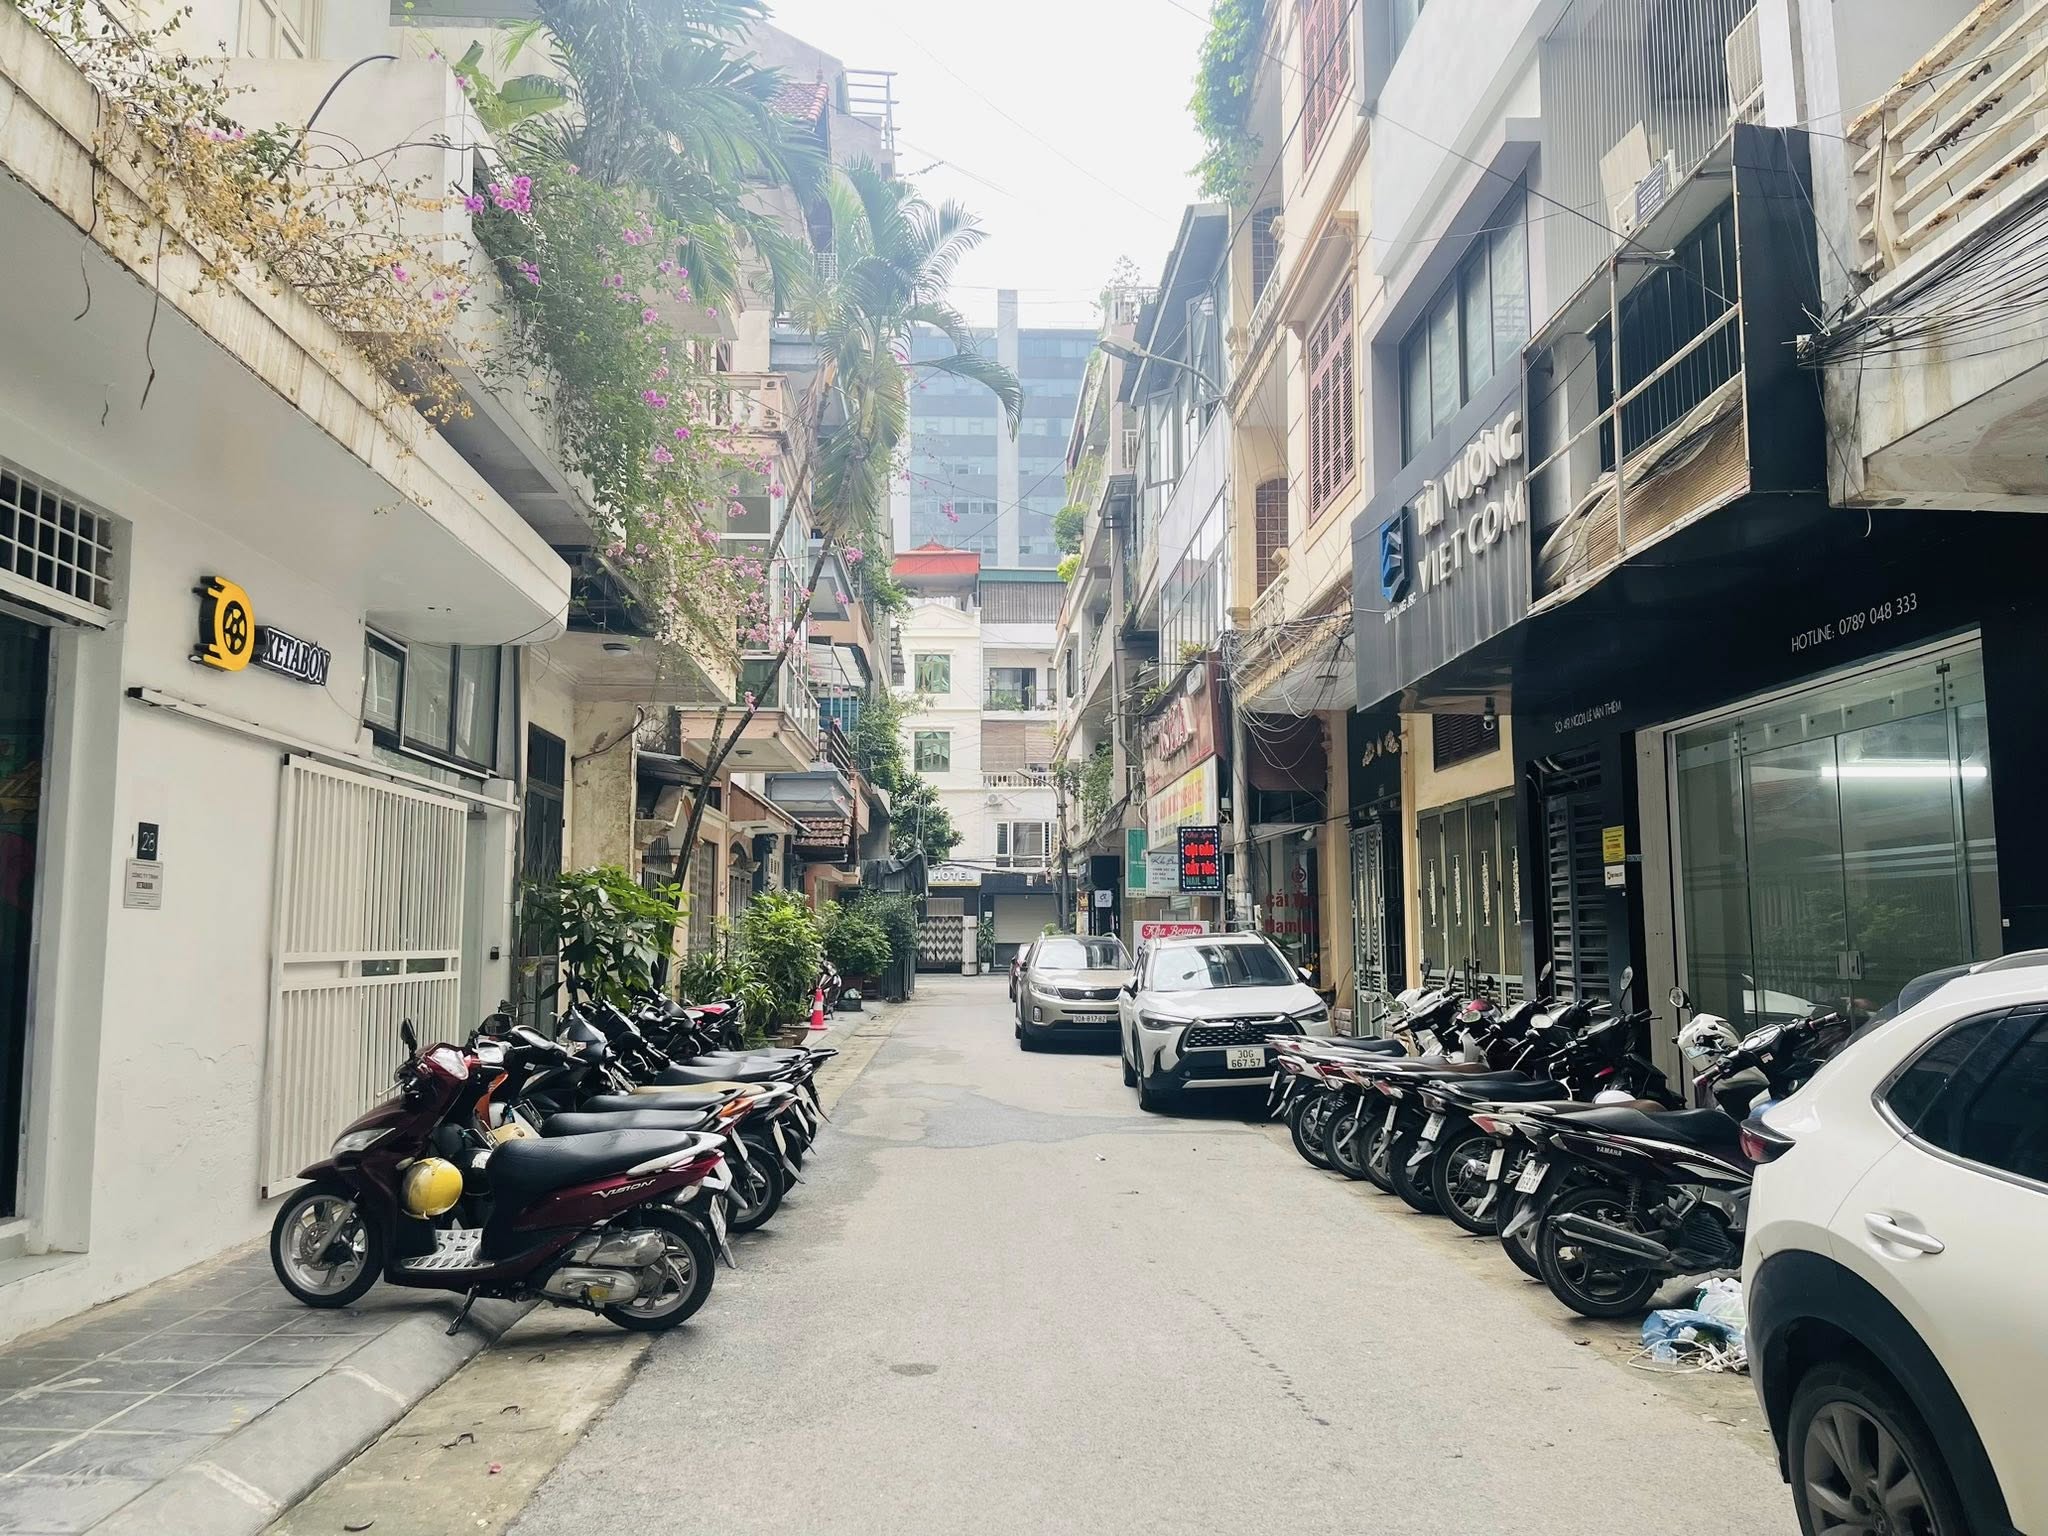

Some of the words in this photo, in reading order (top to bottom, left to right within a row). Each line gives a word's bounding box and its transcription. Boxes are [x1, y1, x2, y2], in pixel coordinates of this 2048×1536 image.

[1791, 623, 1835, 653] HOTLINE:
[1838, 612, 1866, 636] 0789
[1869, 602, 1892, 625] 048
[1896, 592, 1917, 615] 333
[933, 871, 973, 881] HOTEL
[1144, 925, 1167, 937] Kha
[1236, 1050, 1253, 1058] 30G
[1230, 1059, 1260, 1068] 667.57
[1595, 1145, 1623, 1157] YAMAHA
[591, 1178, 657, 1199] VISION
